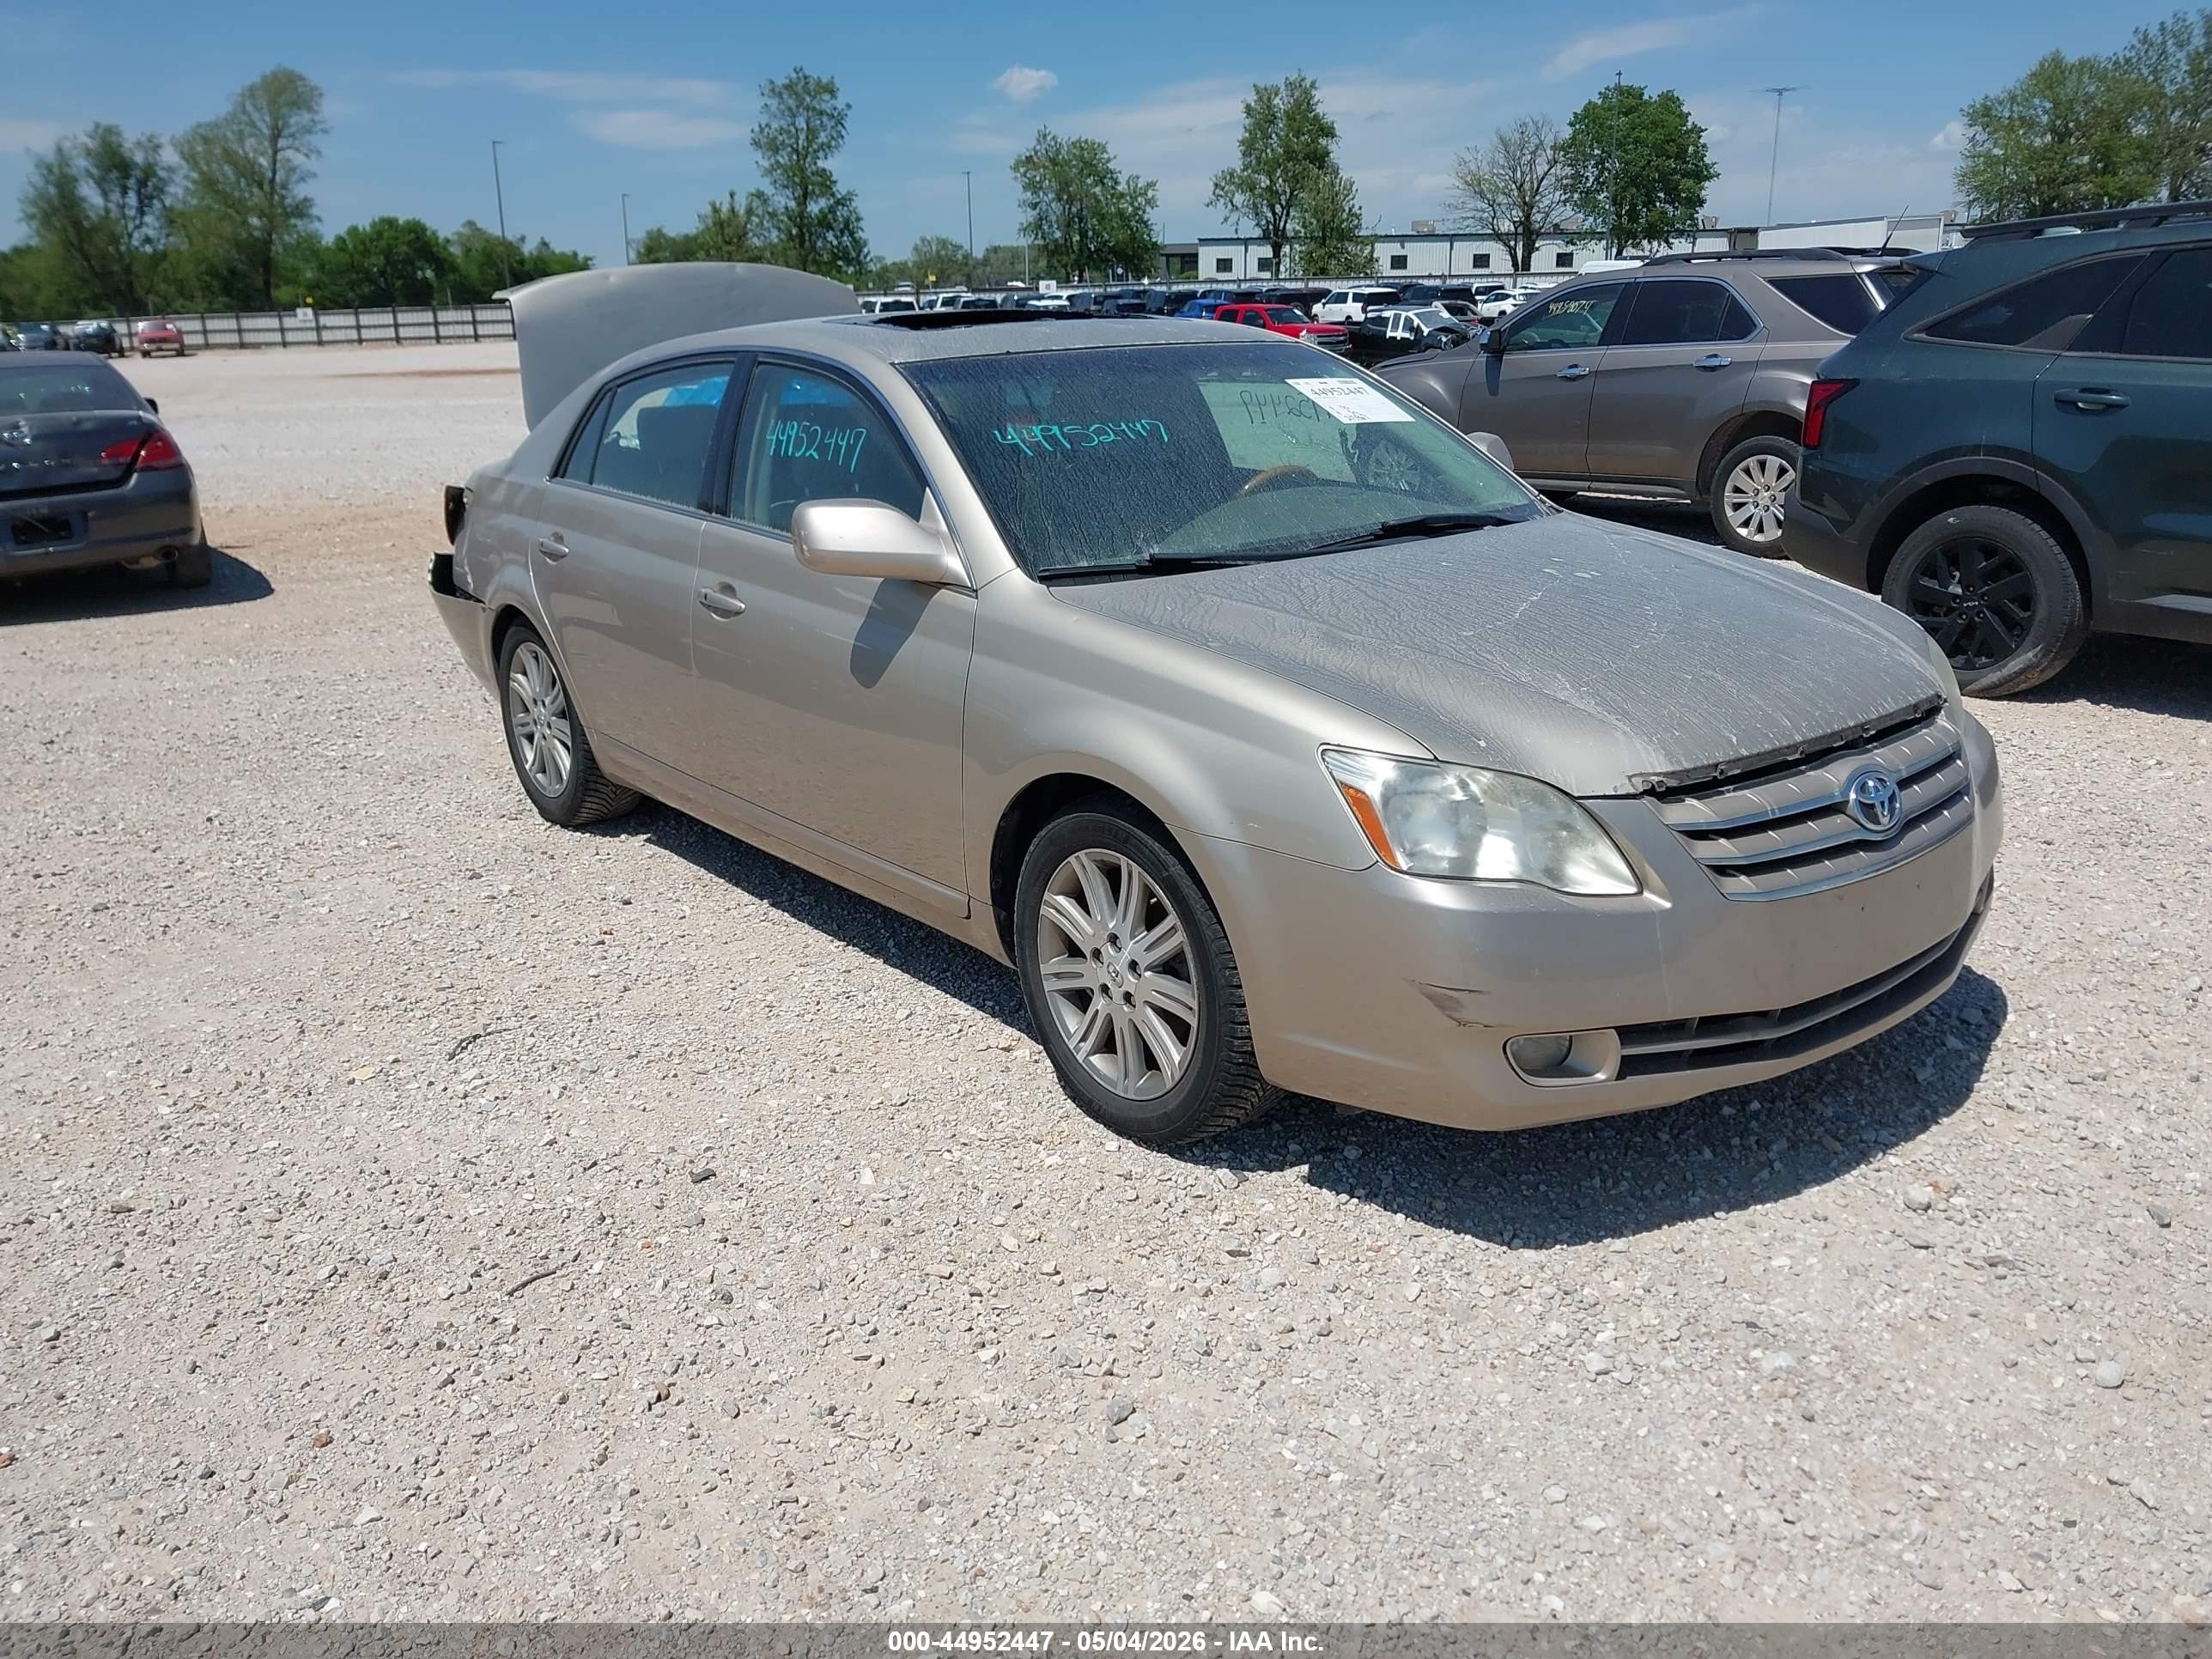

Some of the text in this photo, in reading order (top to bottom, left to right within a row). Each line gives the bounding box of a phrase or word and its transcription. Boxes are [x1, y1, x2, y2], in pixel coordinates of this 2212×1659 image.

[1310, 386, 1369, 397] 44952447
[766, 419, 867, 473] 44952447
[993, 419, 1169, 457] 44952447
